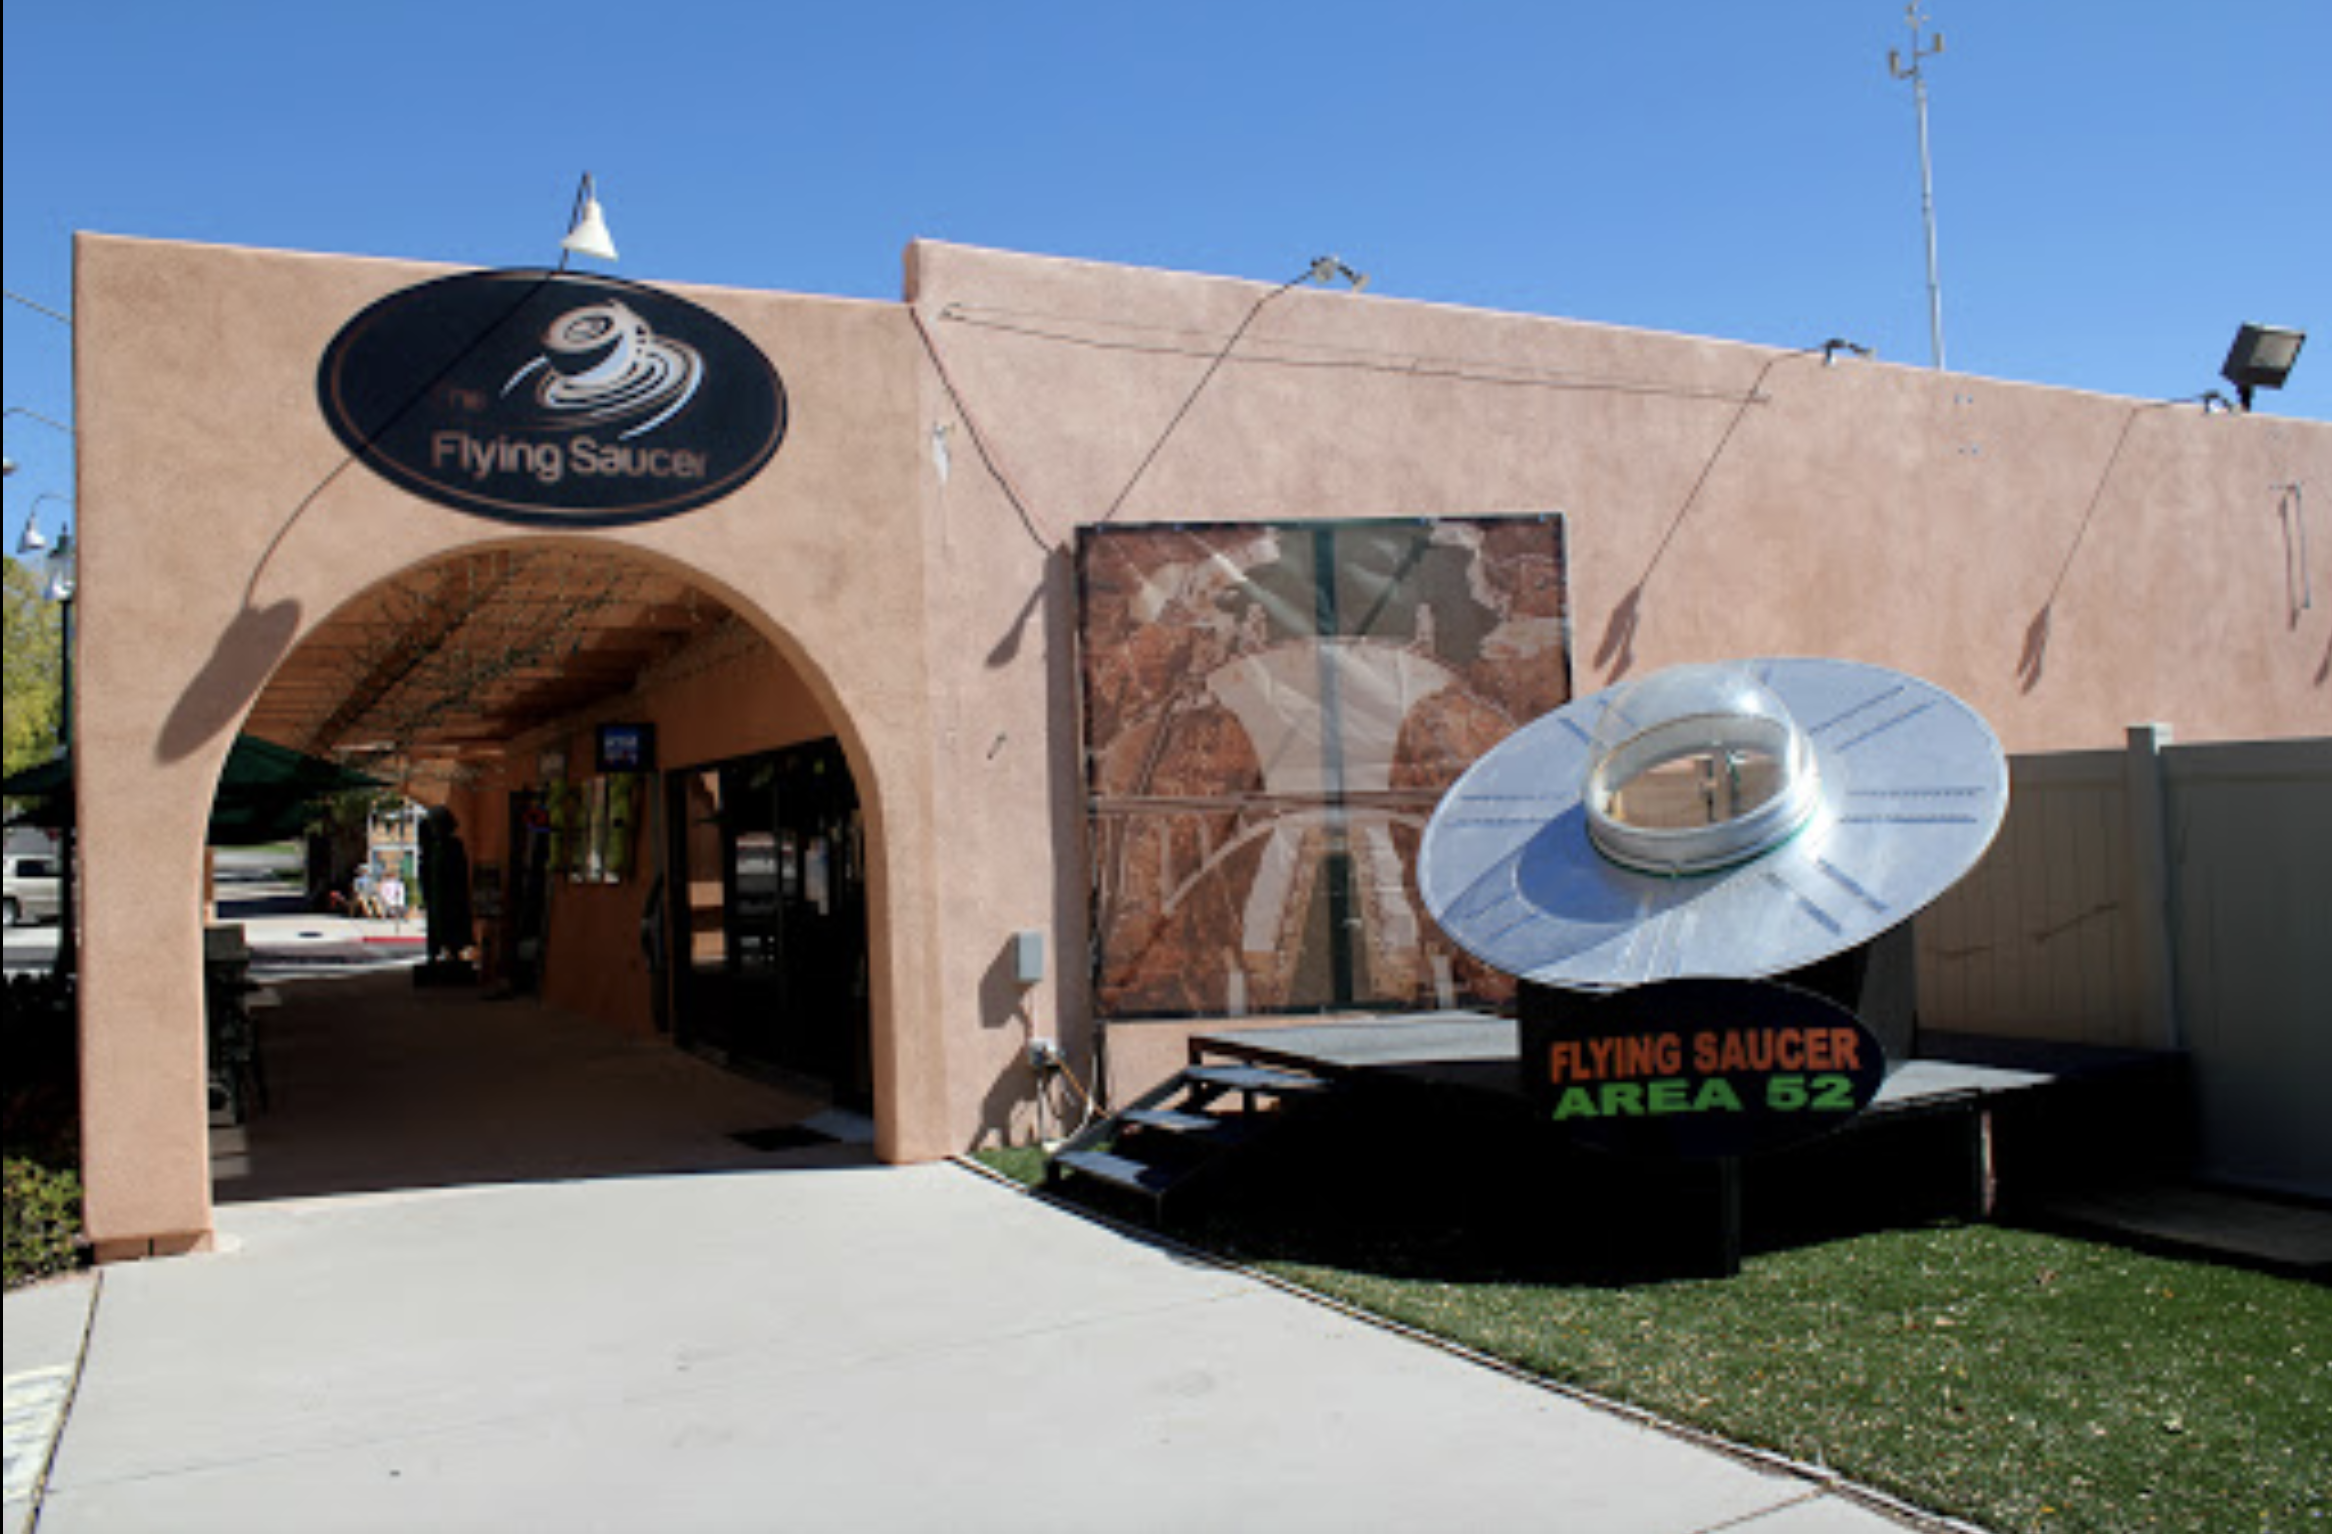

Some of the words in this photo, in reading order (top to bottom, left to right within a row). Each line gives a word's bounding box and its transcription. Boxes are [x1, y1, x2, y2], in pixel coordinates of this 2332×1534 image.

[431, 431, 564, 484] Flying
[569, 434, 706, 477] Saucer
[1550, 1031, 1682, 1084] FLYING
[1693, 1026, 1862, 1073] SAUCER
[1551, 1077, 1743, 1120] AREA
[1765, 1073, 1856, 1111] 52
